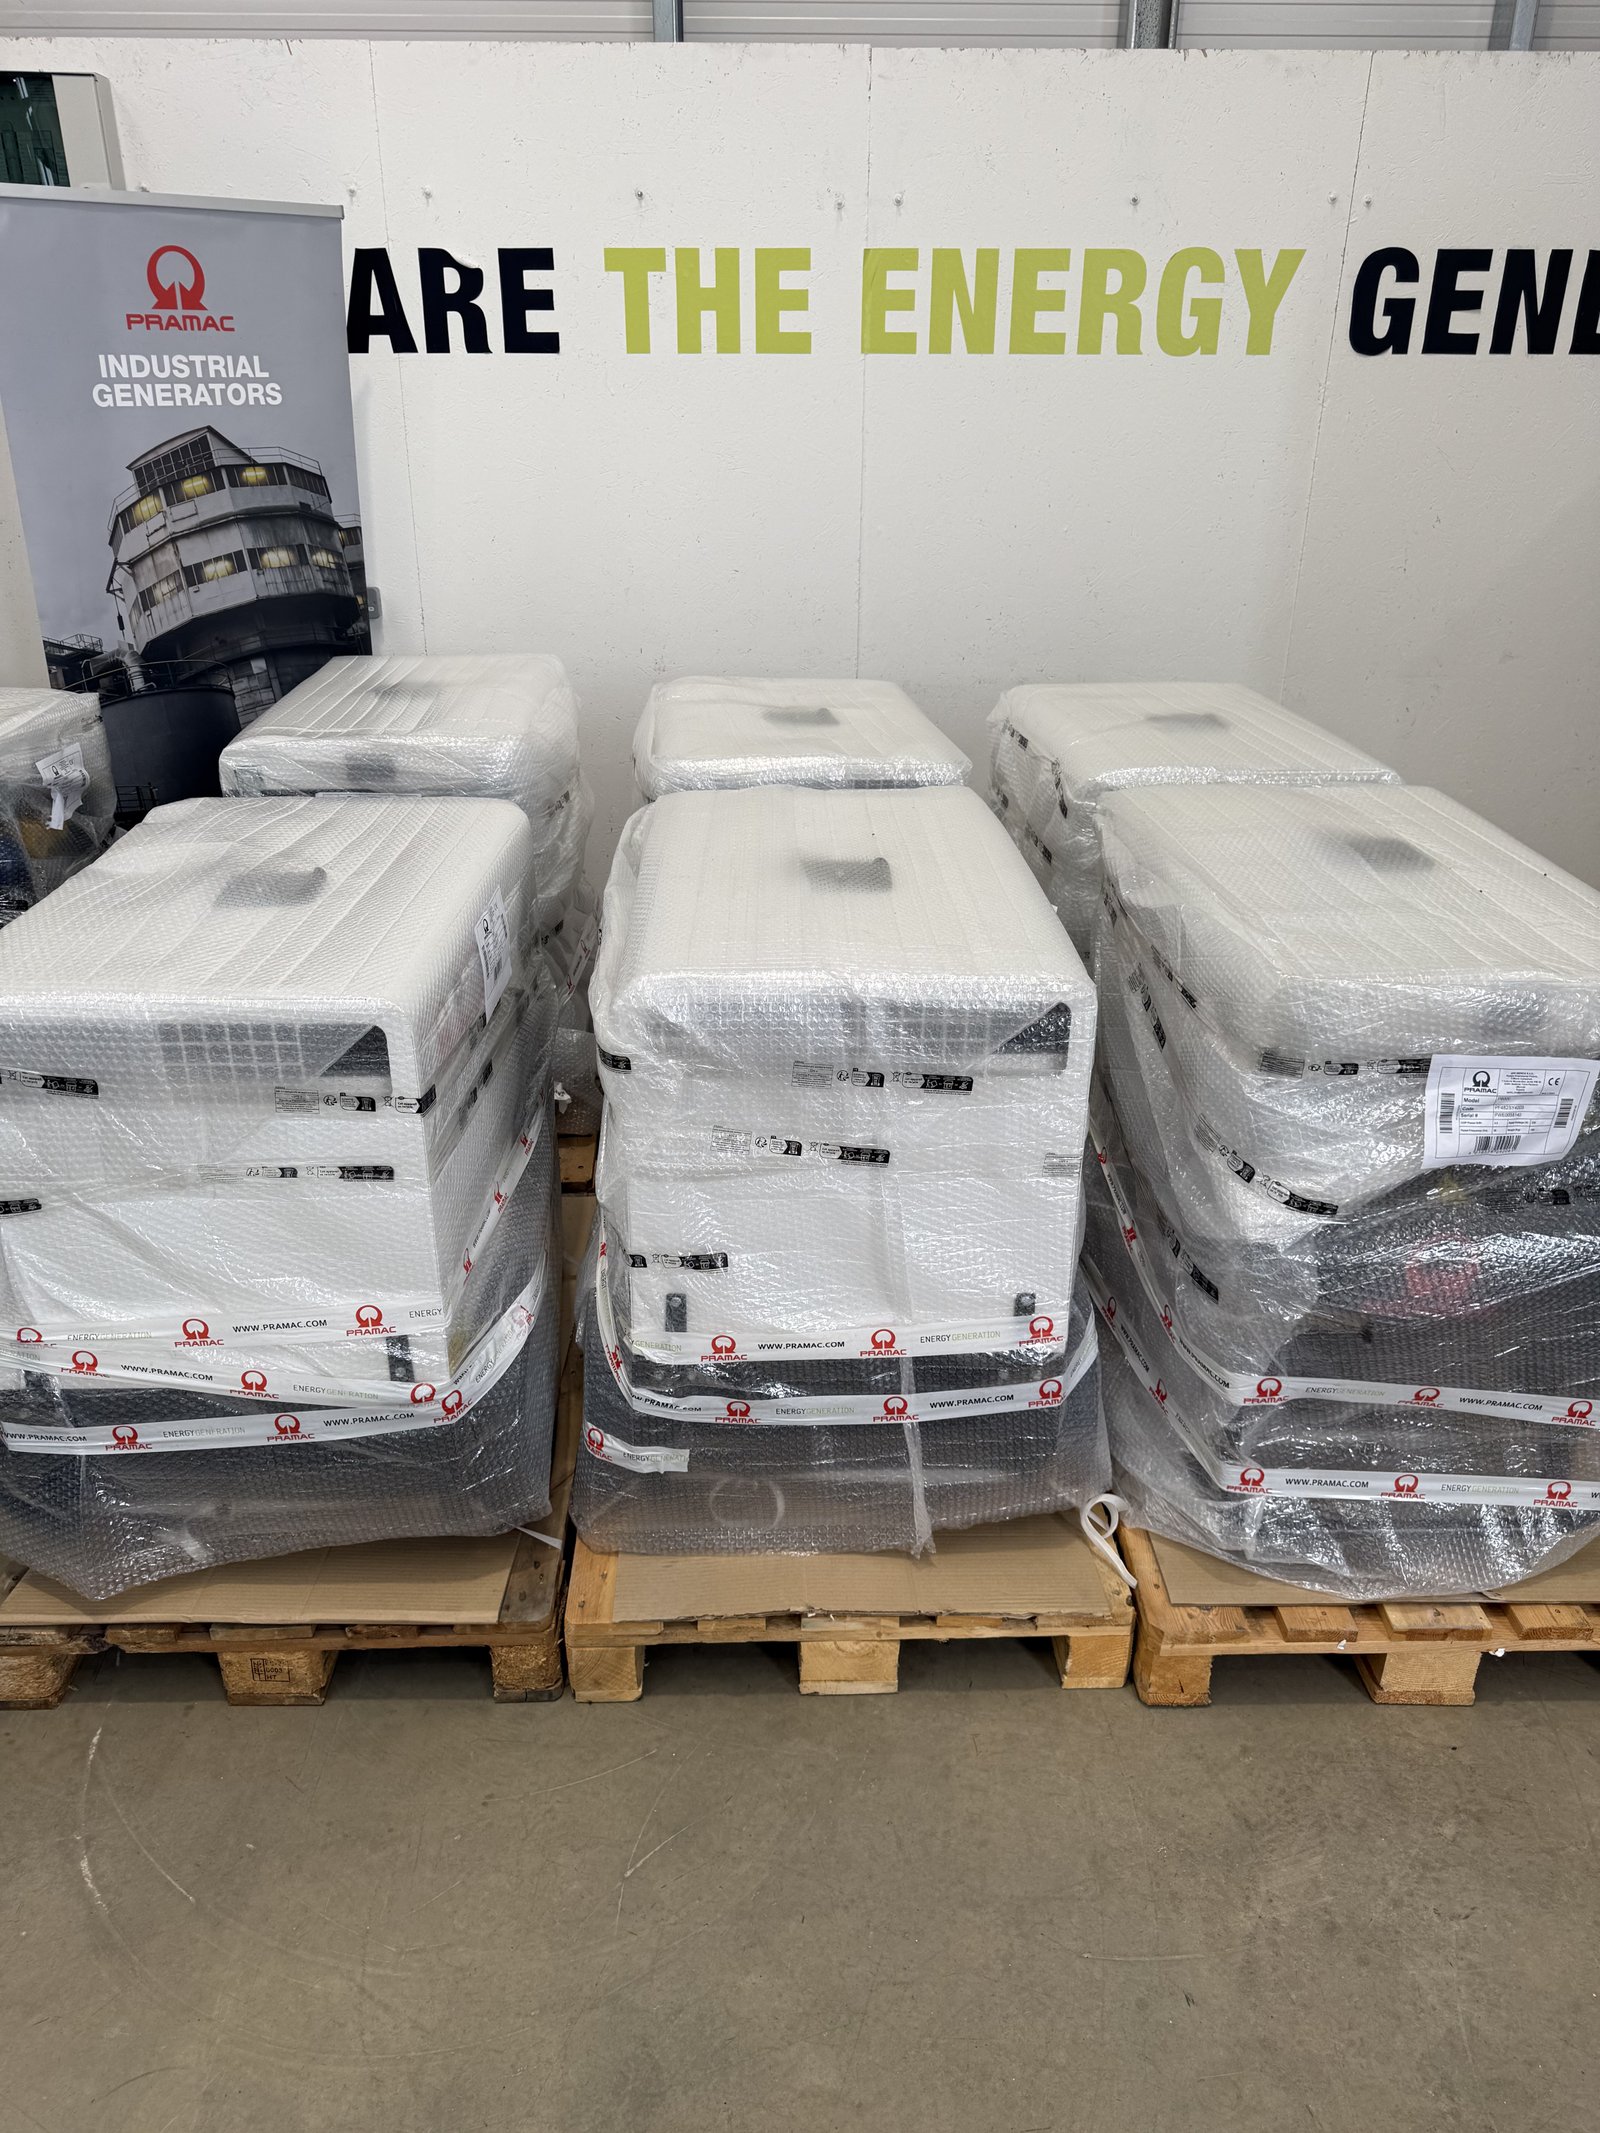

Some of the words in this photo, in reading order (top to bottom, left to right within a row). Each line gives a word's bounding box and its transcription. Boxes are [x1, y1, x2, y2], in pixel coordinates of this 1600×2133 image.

[346, 247, 561, 354] ARE
[603, 247, 813, 355] THE
[860, 247, 1307, 356] ENERGY
[126, 313, 235, 332] PRAMAC
[98, 354, 270, 379] INDUSTRIAL
[92, 383, 283, 408] GENERATORS
[174, 1339, 225, 1348] PRAMAC
[232, 1319, 328, 1334] WWW.PRAMAC.COM
[346, 1325, 397, 1337] PRAMAC
[701, 1353, 748, 1362] PRAMAC
[758, 1340, 846, 1350] WWW.PRAMAC.COM
[859, 1348, 908, 1357] PRAMAC
[920, 1330, 1001, 1344] ENERGYGENERATION
[1018, 1335, 1065, 1348] PRAMAC
[121, 1363, 214, 1382] WWW.PRAMAC.COM
[229, 1388, 280, 1400] PRAMAC
[293, 1384, 379, 1400] ENERGYGENERATION
[714, 1416, 762, 1425] PRAMAC
[775, 1407, 855, 1417] ENERGYGENERATION
[872, 1413, 920, 1423] PRAMAC
[929, 1393, 1015, 1409] WWW.PRAMAC.COM
[1242, 1395, 1291, 1405] PRAMAC
[1304, 1387, 1386, 1397] ENERGYGENERATION
[1397, 1399, 1445, 1409] PRAMAC
[1458, 1396, 1543, 1412] WWW.PRAMAC.COM
[1550, 1416, 1597, 1427] PRAMAC
[105, 1442, 153, 1451] PRAMAC
[162, 1426, 246, 1439] ENERGYGENERATION
[266, 1432, 316, 1443] PRAMAC
[323, 1411, 415, 1428] WWW.PRAMAC.COM
[433, 1398, 473, 1424] PRAMAC
[1226, 1484, 1273, 1494] PRAMAC
[1284, 1477, 1370, 1489] WWW.PRAMAC.COM
[1380, 1491, 1426, 1500] PRAMAC
[1440, 1483, 1520, 1495] ENERGYGENERATION
[1532, 1498, 1579, 1508] PRAMAC
